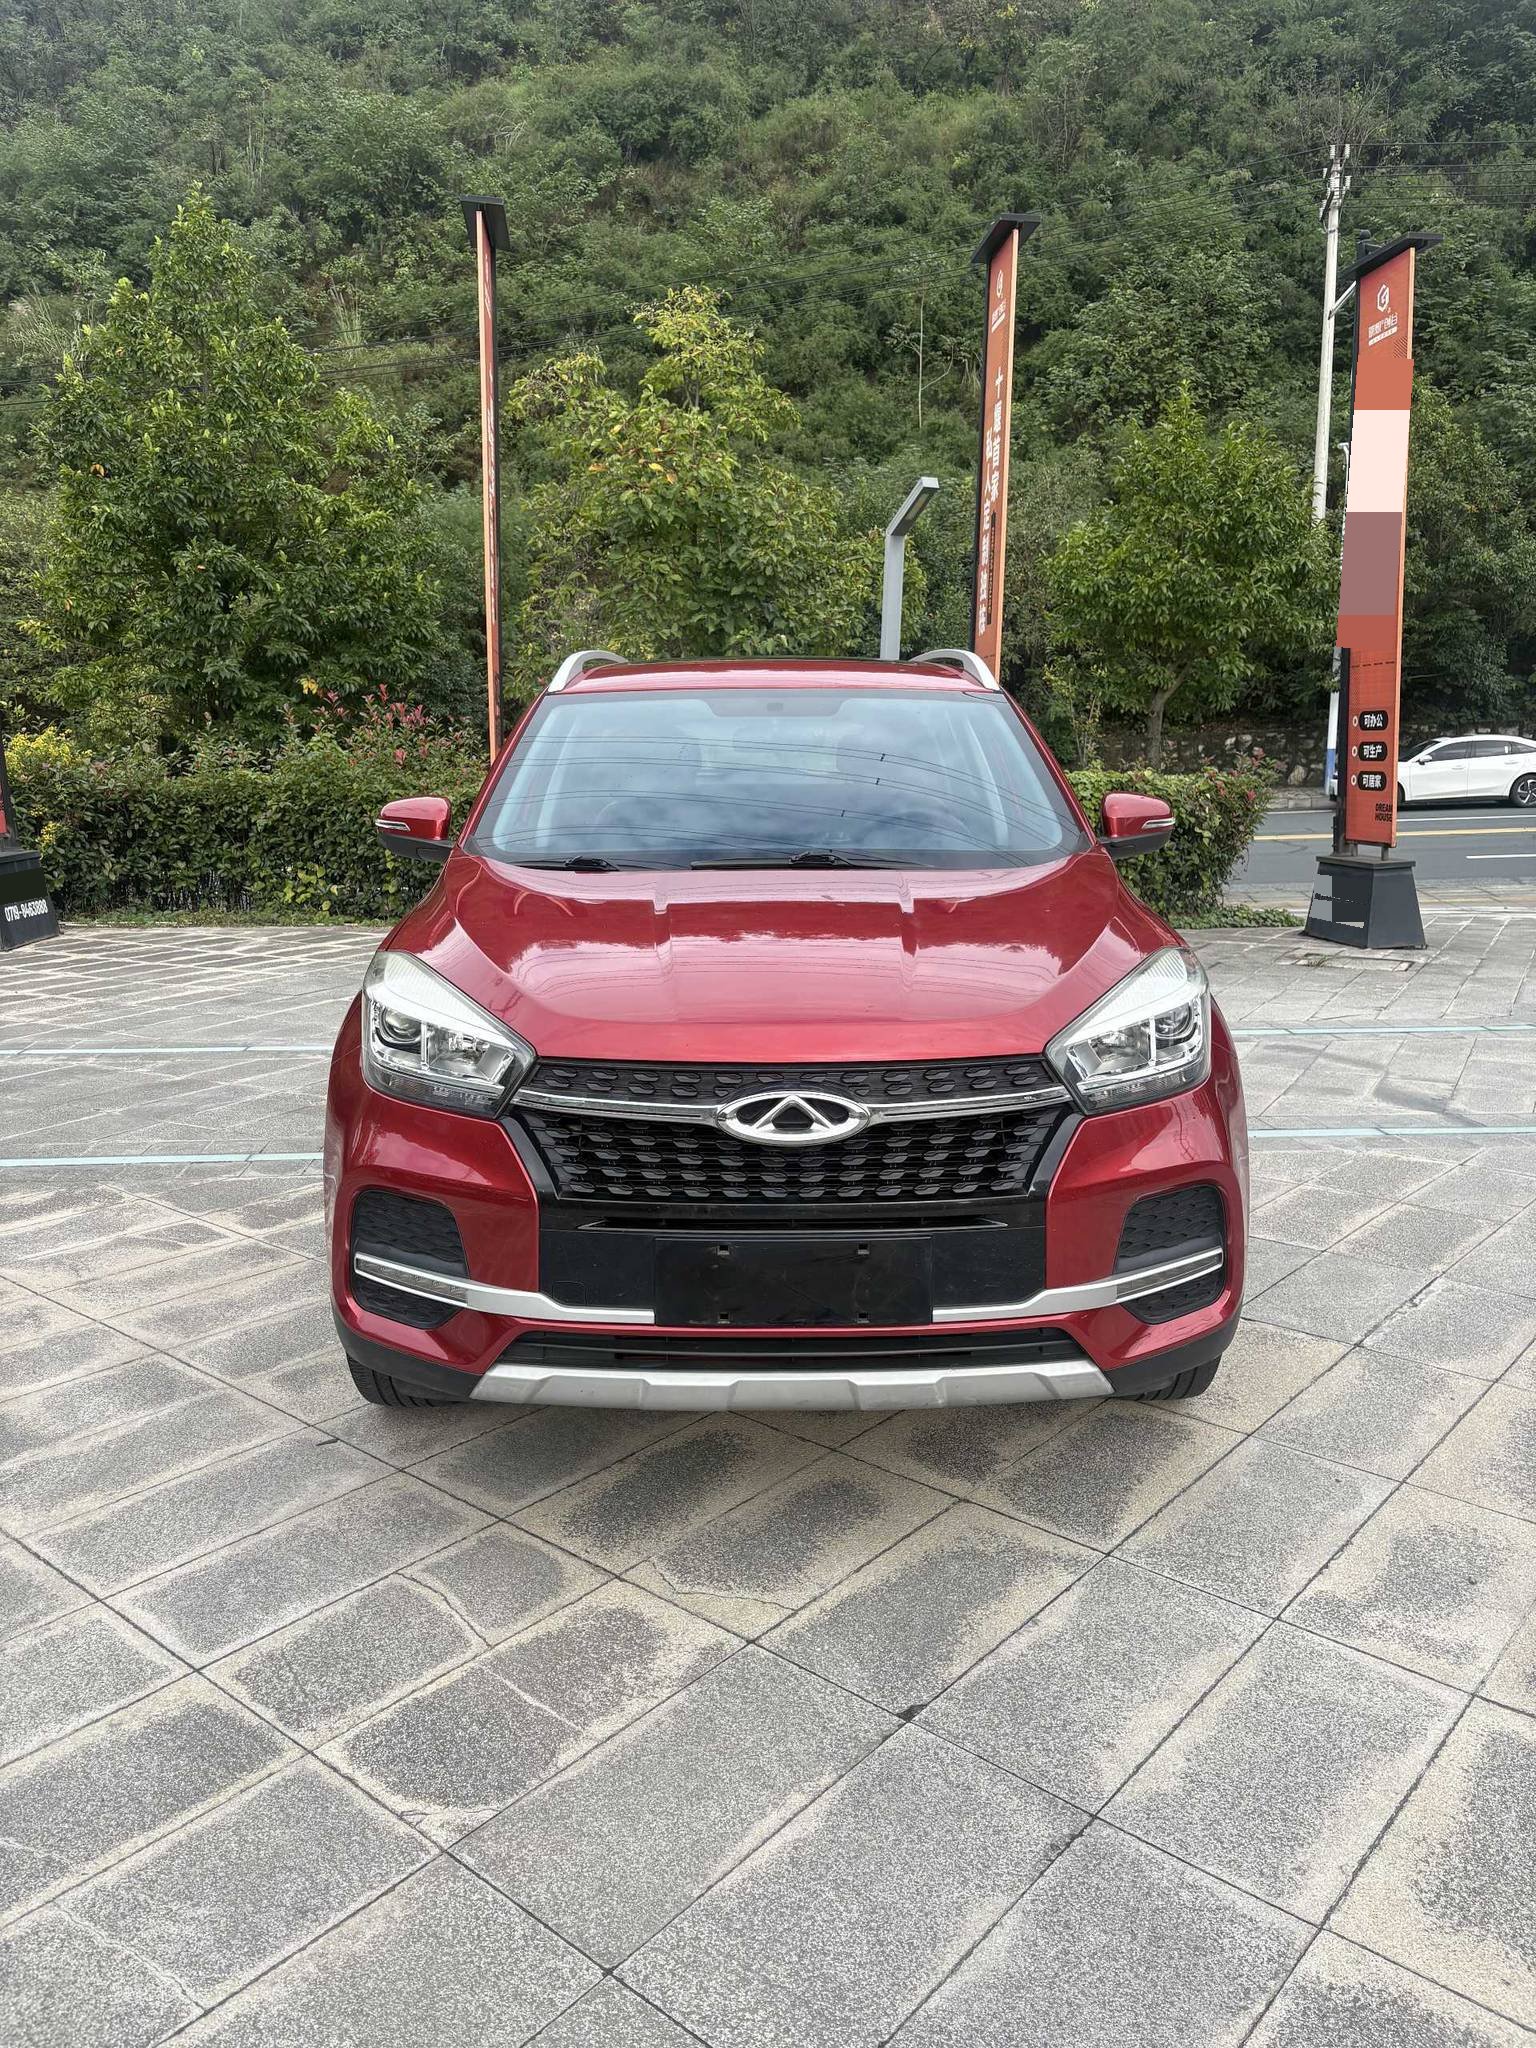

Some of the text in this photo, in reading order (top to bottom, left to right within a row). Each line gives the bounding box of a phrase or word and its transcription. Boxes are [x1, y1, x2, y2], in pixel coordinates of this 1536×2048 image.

[1363, 713, 1384, 728] 可办公
[1362, 744, 1383, 759] 可生产
[1361, 774, 1382, 788] 可居家
[1375, 812, 1393, 822] HOUSE
